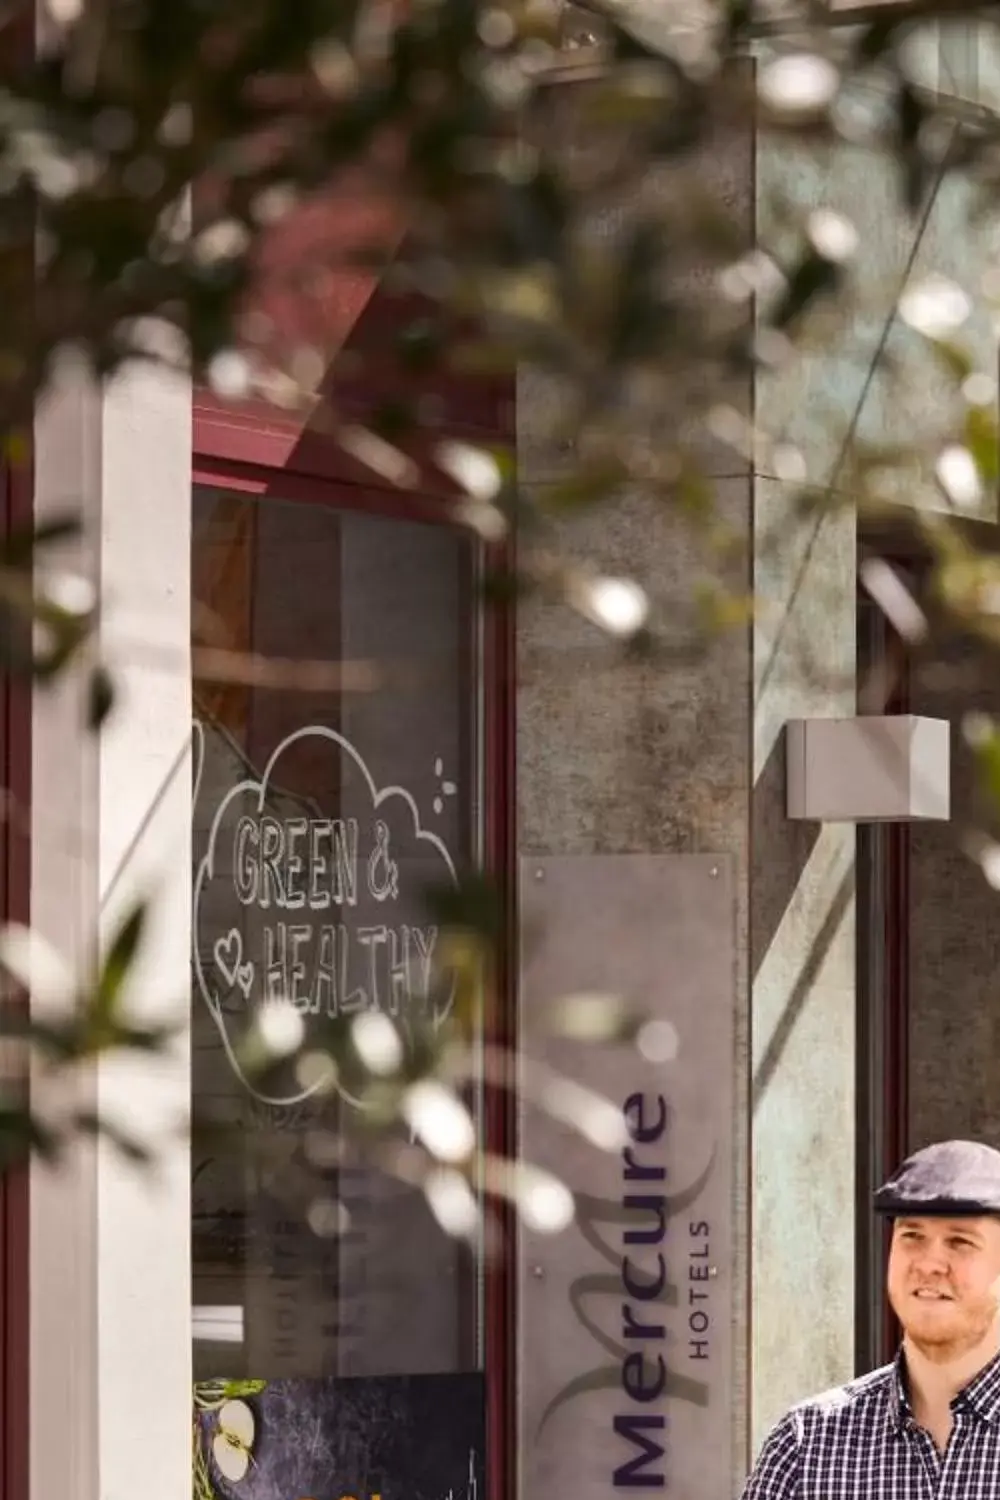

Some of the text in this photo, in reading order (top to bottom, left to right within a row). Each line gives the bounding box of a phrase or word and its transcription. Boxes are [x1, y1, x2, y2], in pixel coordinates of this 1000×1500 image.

[233, 815, 399, 910] GREEN &
[263, 921, 439, 1020] HEALTHY
[612, 1091, 668, 1489] Mercure
[689, 1220, 710, 1360] HOTELS
